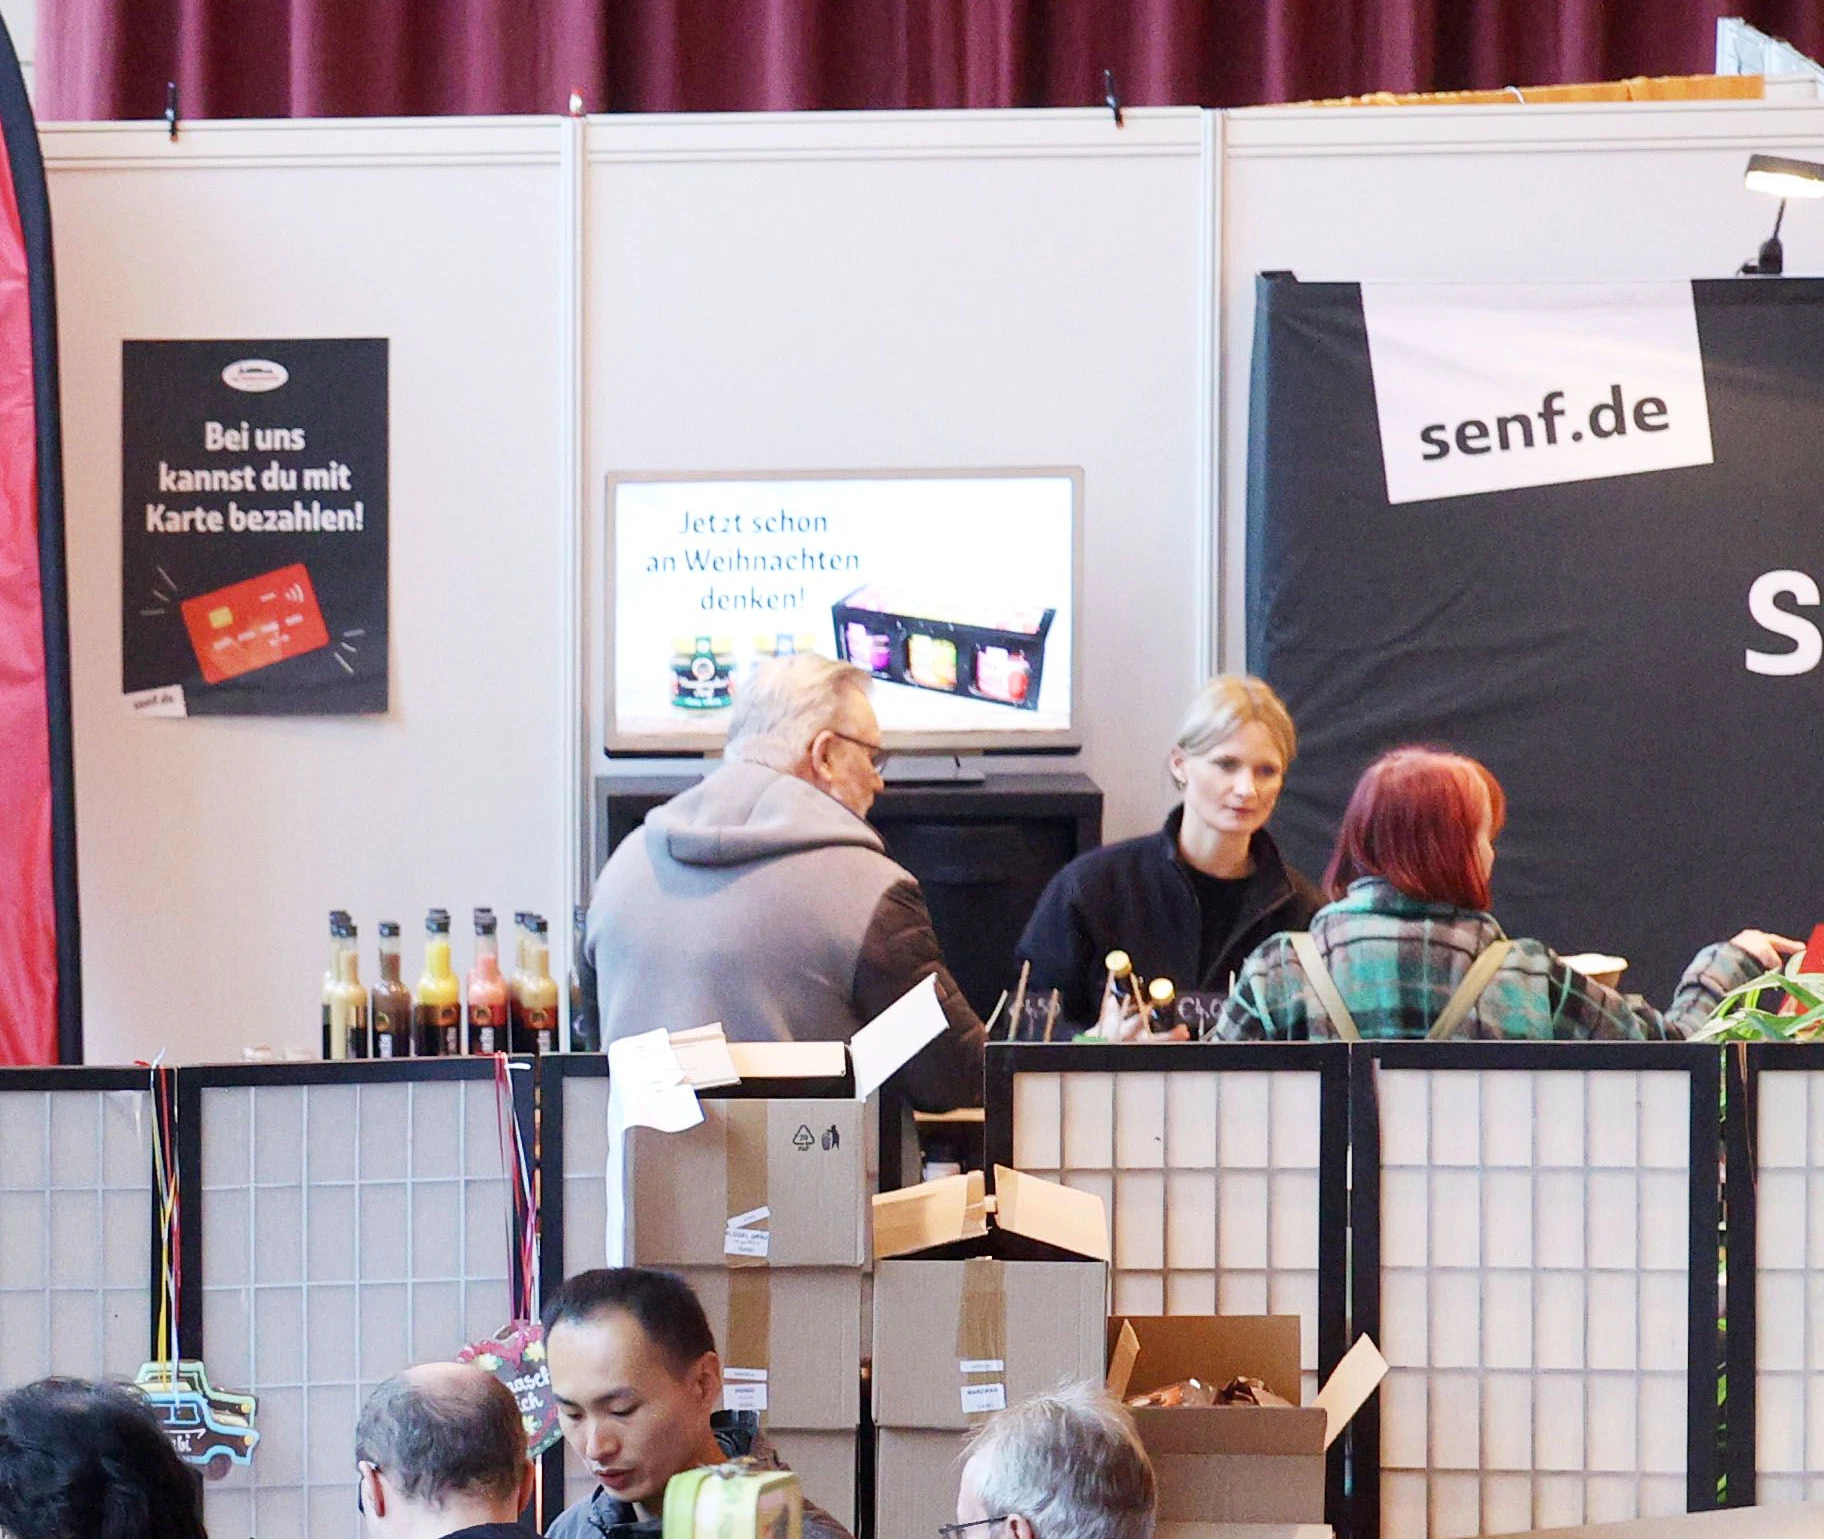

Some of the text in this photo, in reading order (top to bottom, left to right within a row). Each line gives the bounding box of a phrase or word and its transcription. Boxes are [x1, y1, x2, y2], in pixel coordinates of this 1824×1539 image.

[204, 422, 305, 451] Bei uns
[1420, 384, 1671, 461] senf.de
[158, 461, 351, 492] kannst du mit
[145, 502, 364, 532] Karte bezahlen!
[678, 509, 828, 535] Jetzt schon
[646, 548, 860, 573] an Weihnachten
[700, 587, 805, 610] denken!
